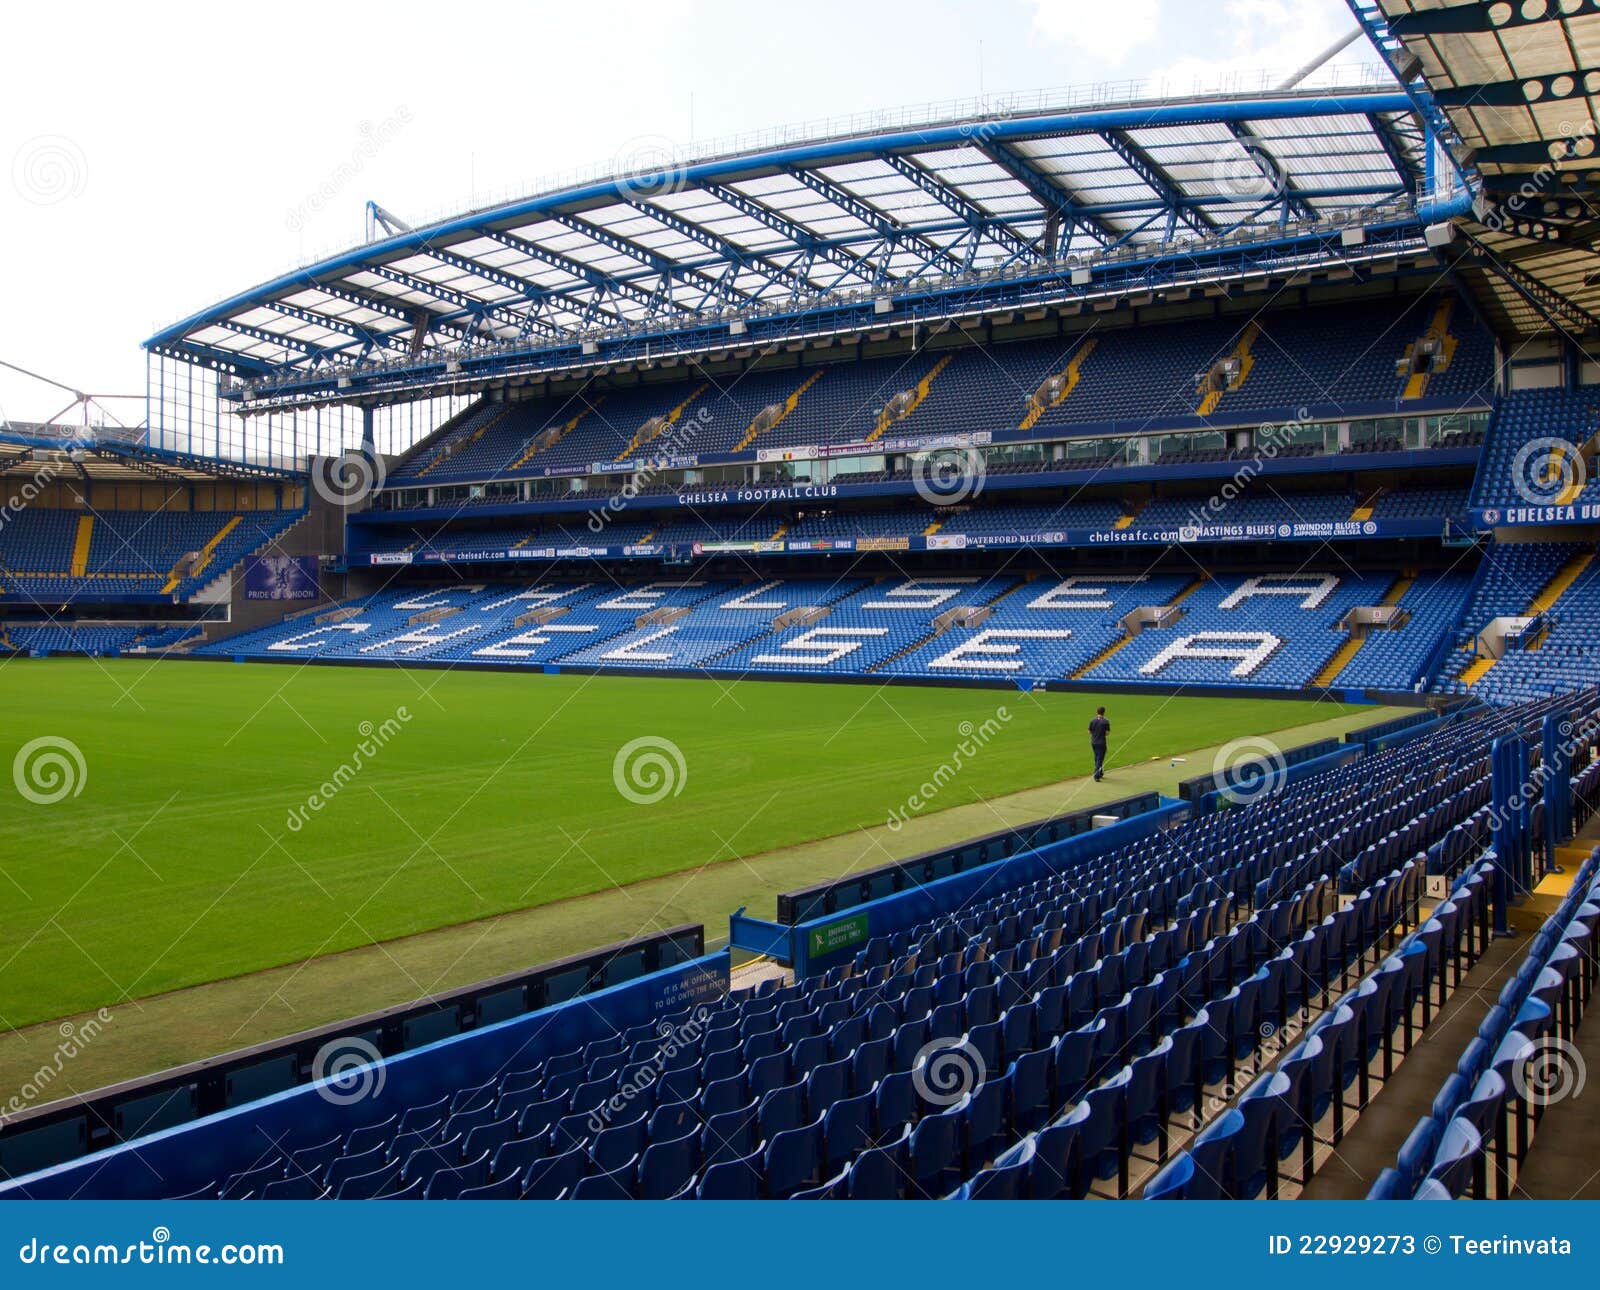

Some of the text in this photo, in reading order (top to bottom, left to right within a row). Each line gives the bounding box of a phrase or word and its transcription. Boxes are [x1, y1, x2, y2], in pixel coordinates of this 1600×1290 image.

[601, 462, 634, 471] East Cornwall
[679, 486, 838, 504] CHELSEA FOOTBALL CLUB
[1507, 505, 1575, 523] CHELSEA
[1196, 524, 1275, 537] HASTINGS BLUES
[1293, 521, 1361, 531] SWINDON BLUES
[1089, 530, 1179, 543] chelseafc.com
[1293, 528, 1361, 537] SUPPORTING CHELSEA
[966, 534, 1047, 544] WATERFORD BLUES
[788, 542, 811, 550] CHELSEA
[457, 551, 505, 560] chelseafc.com
[248, 590, 269, 599] PRIDE
[282, 590, 314, 599] LONDON
[266, 622, 1282, 677] CHELSEA
[1432, 880, 1440, 892] J
[663, 970, 718, 995] IT IS AN OFFENCE
[655, 1001, 664, 1010] TO
[678, 989, 695, 1001] ONTO
[697, 984, 707, 994] THE
[709, 978, 726, 990] PITCH
